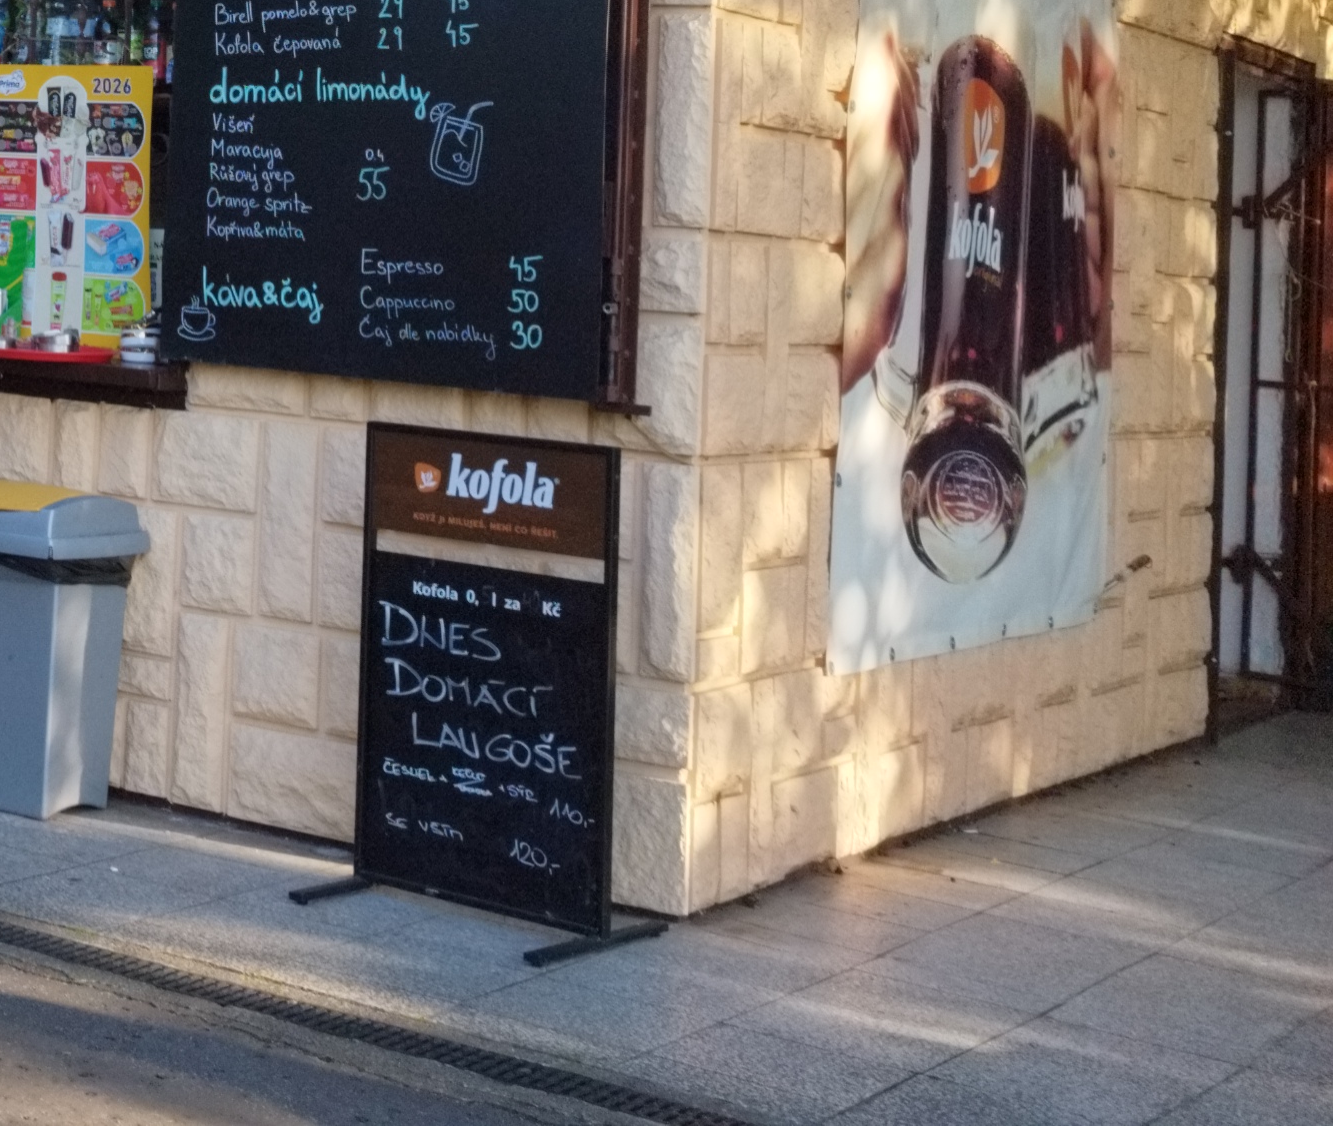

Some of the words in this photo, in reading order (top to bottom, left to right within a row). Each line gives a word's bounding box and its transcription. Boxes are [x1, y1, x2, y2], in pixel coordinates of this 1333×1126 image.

[215, 1, 253, 25] Birell
[215, 30, 264, 55] Kofola
[273, 26, 341, 59] čepovaná
[377, 26, 402, 51] 29
[446, 19, 479, 47] 45
[92, 78, 131, 94] 2026
[209, 66, 303, 103] domácí
[316, 66, 430, 120] limonády
[213, 112, 255, 134] Višeň
[211, 138, 283, 169] Maracuja
[209, 162, 258, 191] Růžový
[262, 170, 295, 193] grep
[356, 166, 390, 200] 55
[207, 187, 260, 217] Orange
[264, 192, 312, 217] spritz
[949, 202, 1001, 278] kofola
[361, 248, 444, 283] Espresso
[509, 255, 543, 282] 45
[360, 285, 455, 321] Cappuccino
[507, 289, 539, 313] 50
[359, 314, 392, 346] Čaj
[399, 323, 420, 341] dle
[510, 322, 543, 349] 30
[446, 452, 555, 514] kofola
[514, 525, 528, 534] CO
[412, 581, 458, 601] Kofola
[504, 598, 520, 611] za
[542, 599, 561, 618] Kč
[379, 601, 502, 662] DNES
[385, 657, 553, 719] DOMÁCÍ
